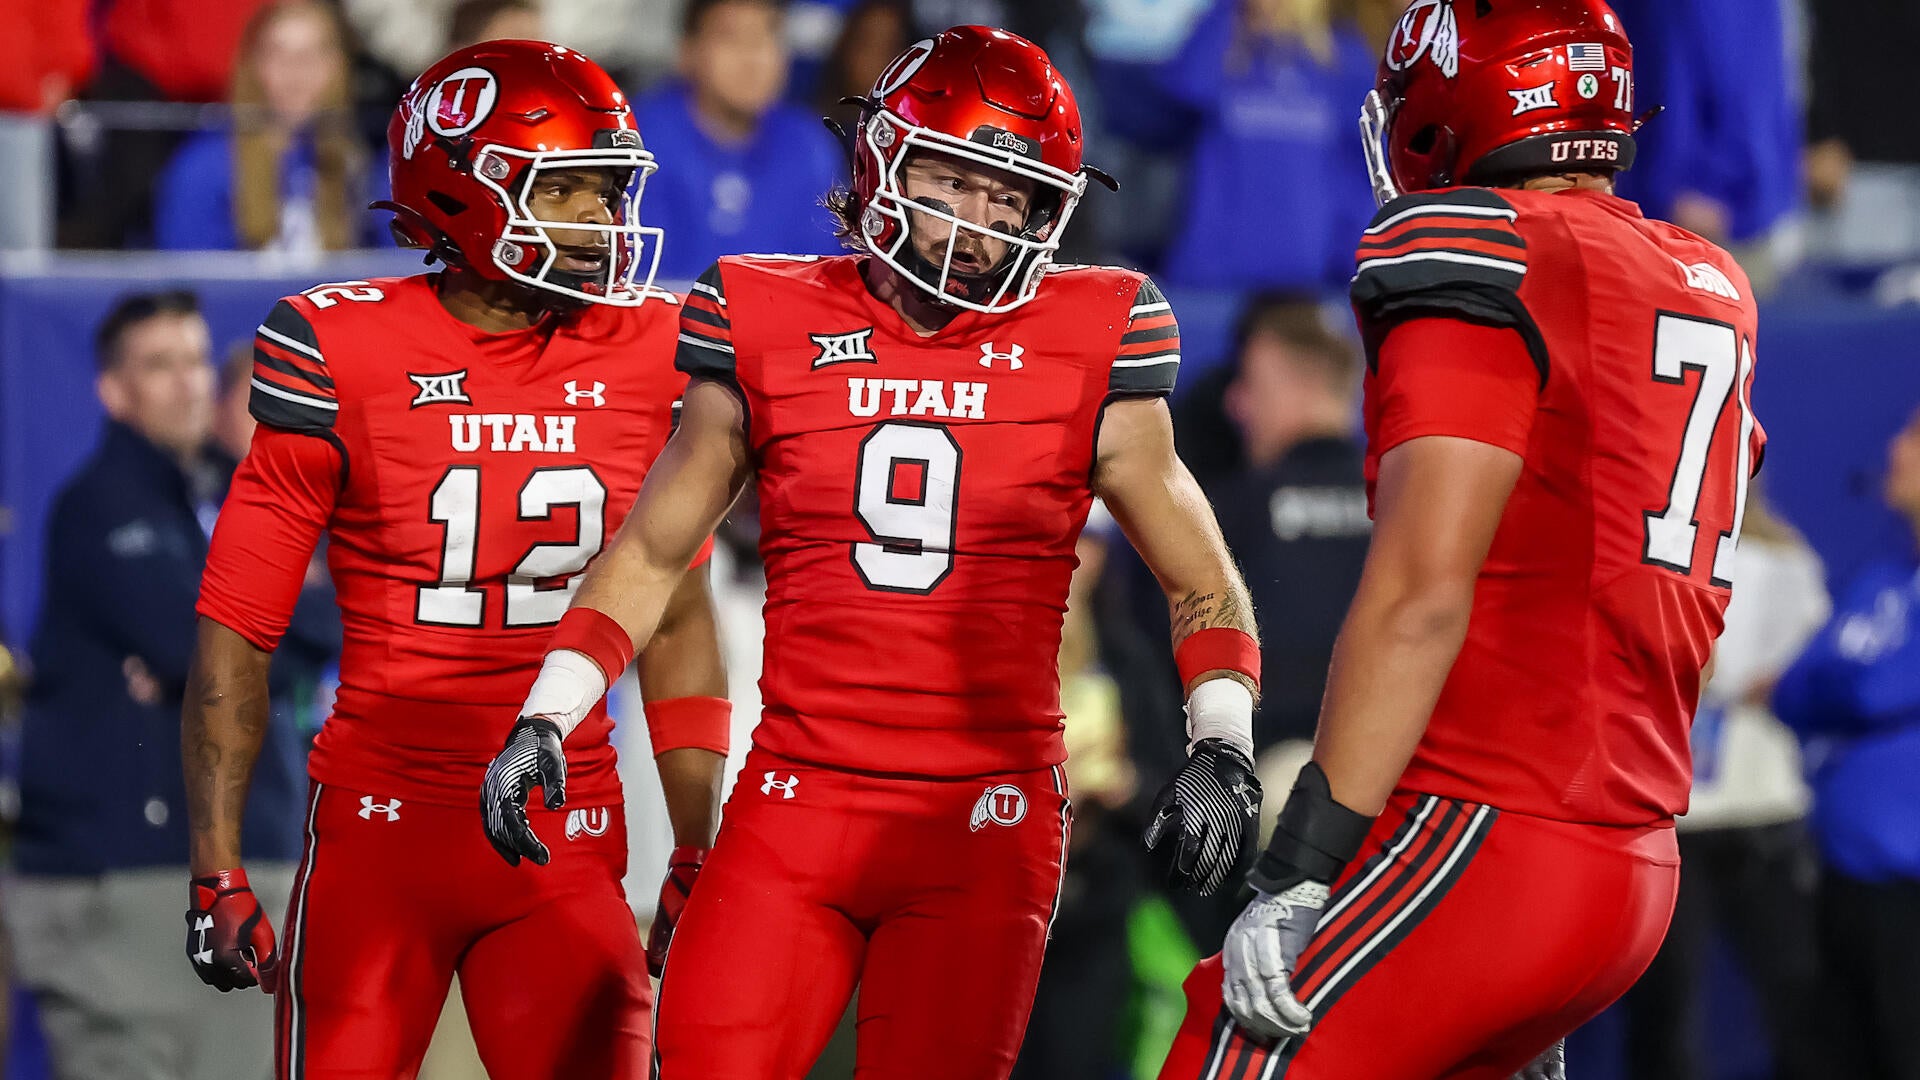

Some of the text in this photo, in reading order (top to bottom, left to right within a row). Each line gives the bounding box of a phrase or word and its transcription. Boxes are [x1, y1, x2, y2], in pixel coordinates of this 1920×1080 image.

[437, 77, 491, 131] U
[1507, 81, 1560, 116] XII
[1611, 66, 1631, 112] 71
[1550, 140, 1619, 162] UTES
[810, 328, 877, 371] XII
[407, 368, 473, 410] XII
[847, 377, 989, 420] UTAH
[448, 413, 577, 453] UTAH
[849, 418, 963, 596] 9
[414, 464, 608, 629] 12
[994, 793, 1020, 821] U
